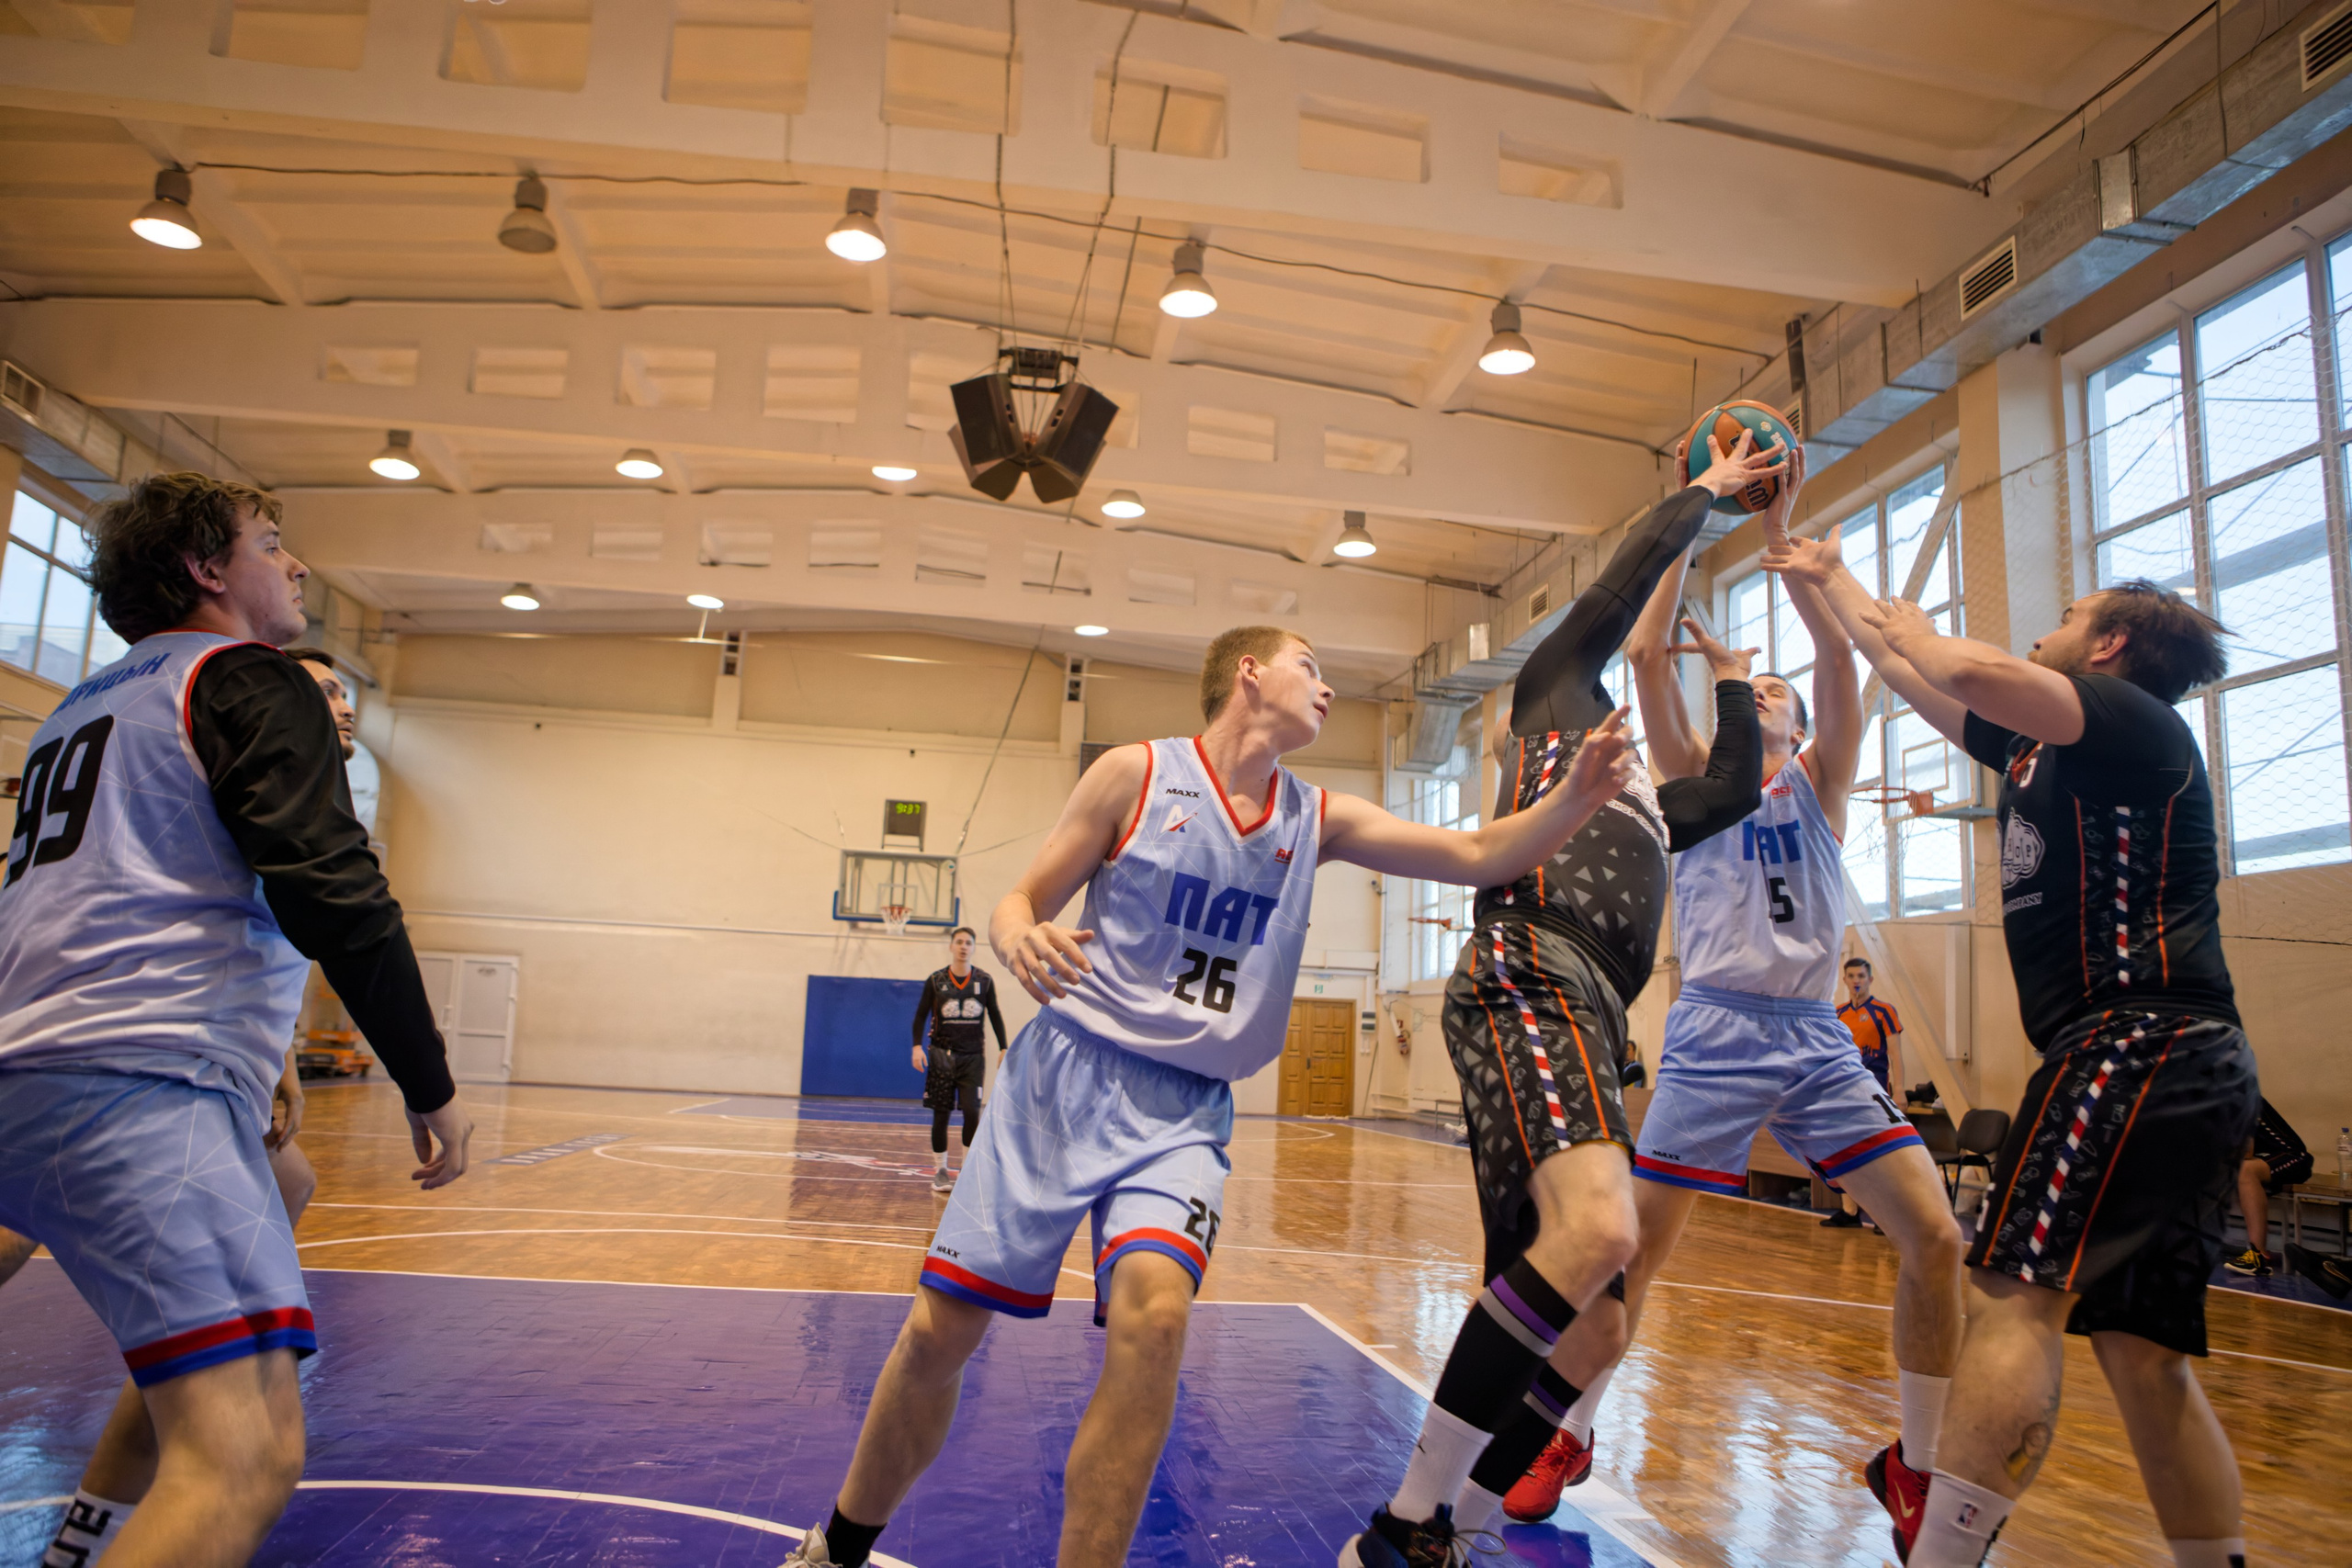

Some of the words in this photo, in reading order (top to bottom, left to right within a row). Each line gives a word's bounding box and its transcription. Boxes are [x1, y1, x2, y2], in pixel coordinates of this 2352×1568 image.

[5, 715, 114, 889] 99
[1166, 788, 1200, 799] MAXX
[1164, 872, 1280, 946] ПАТ
[1769, 877, 1794, 924] 5
[1173, 947, 1238, 1013] 26
